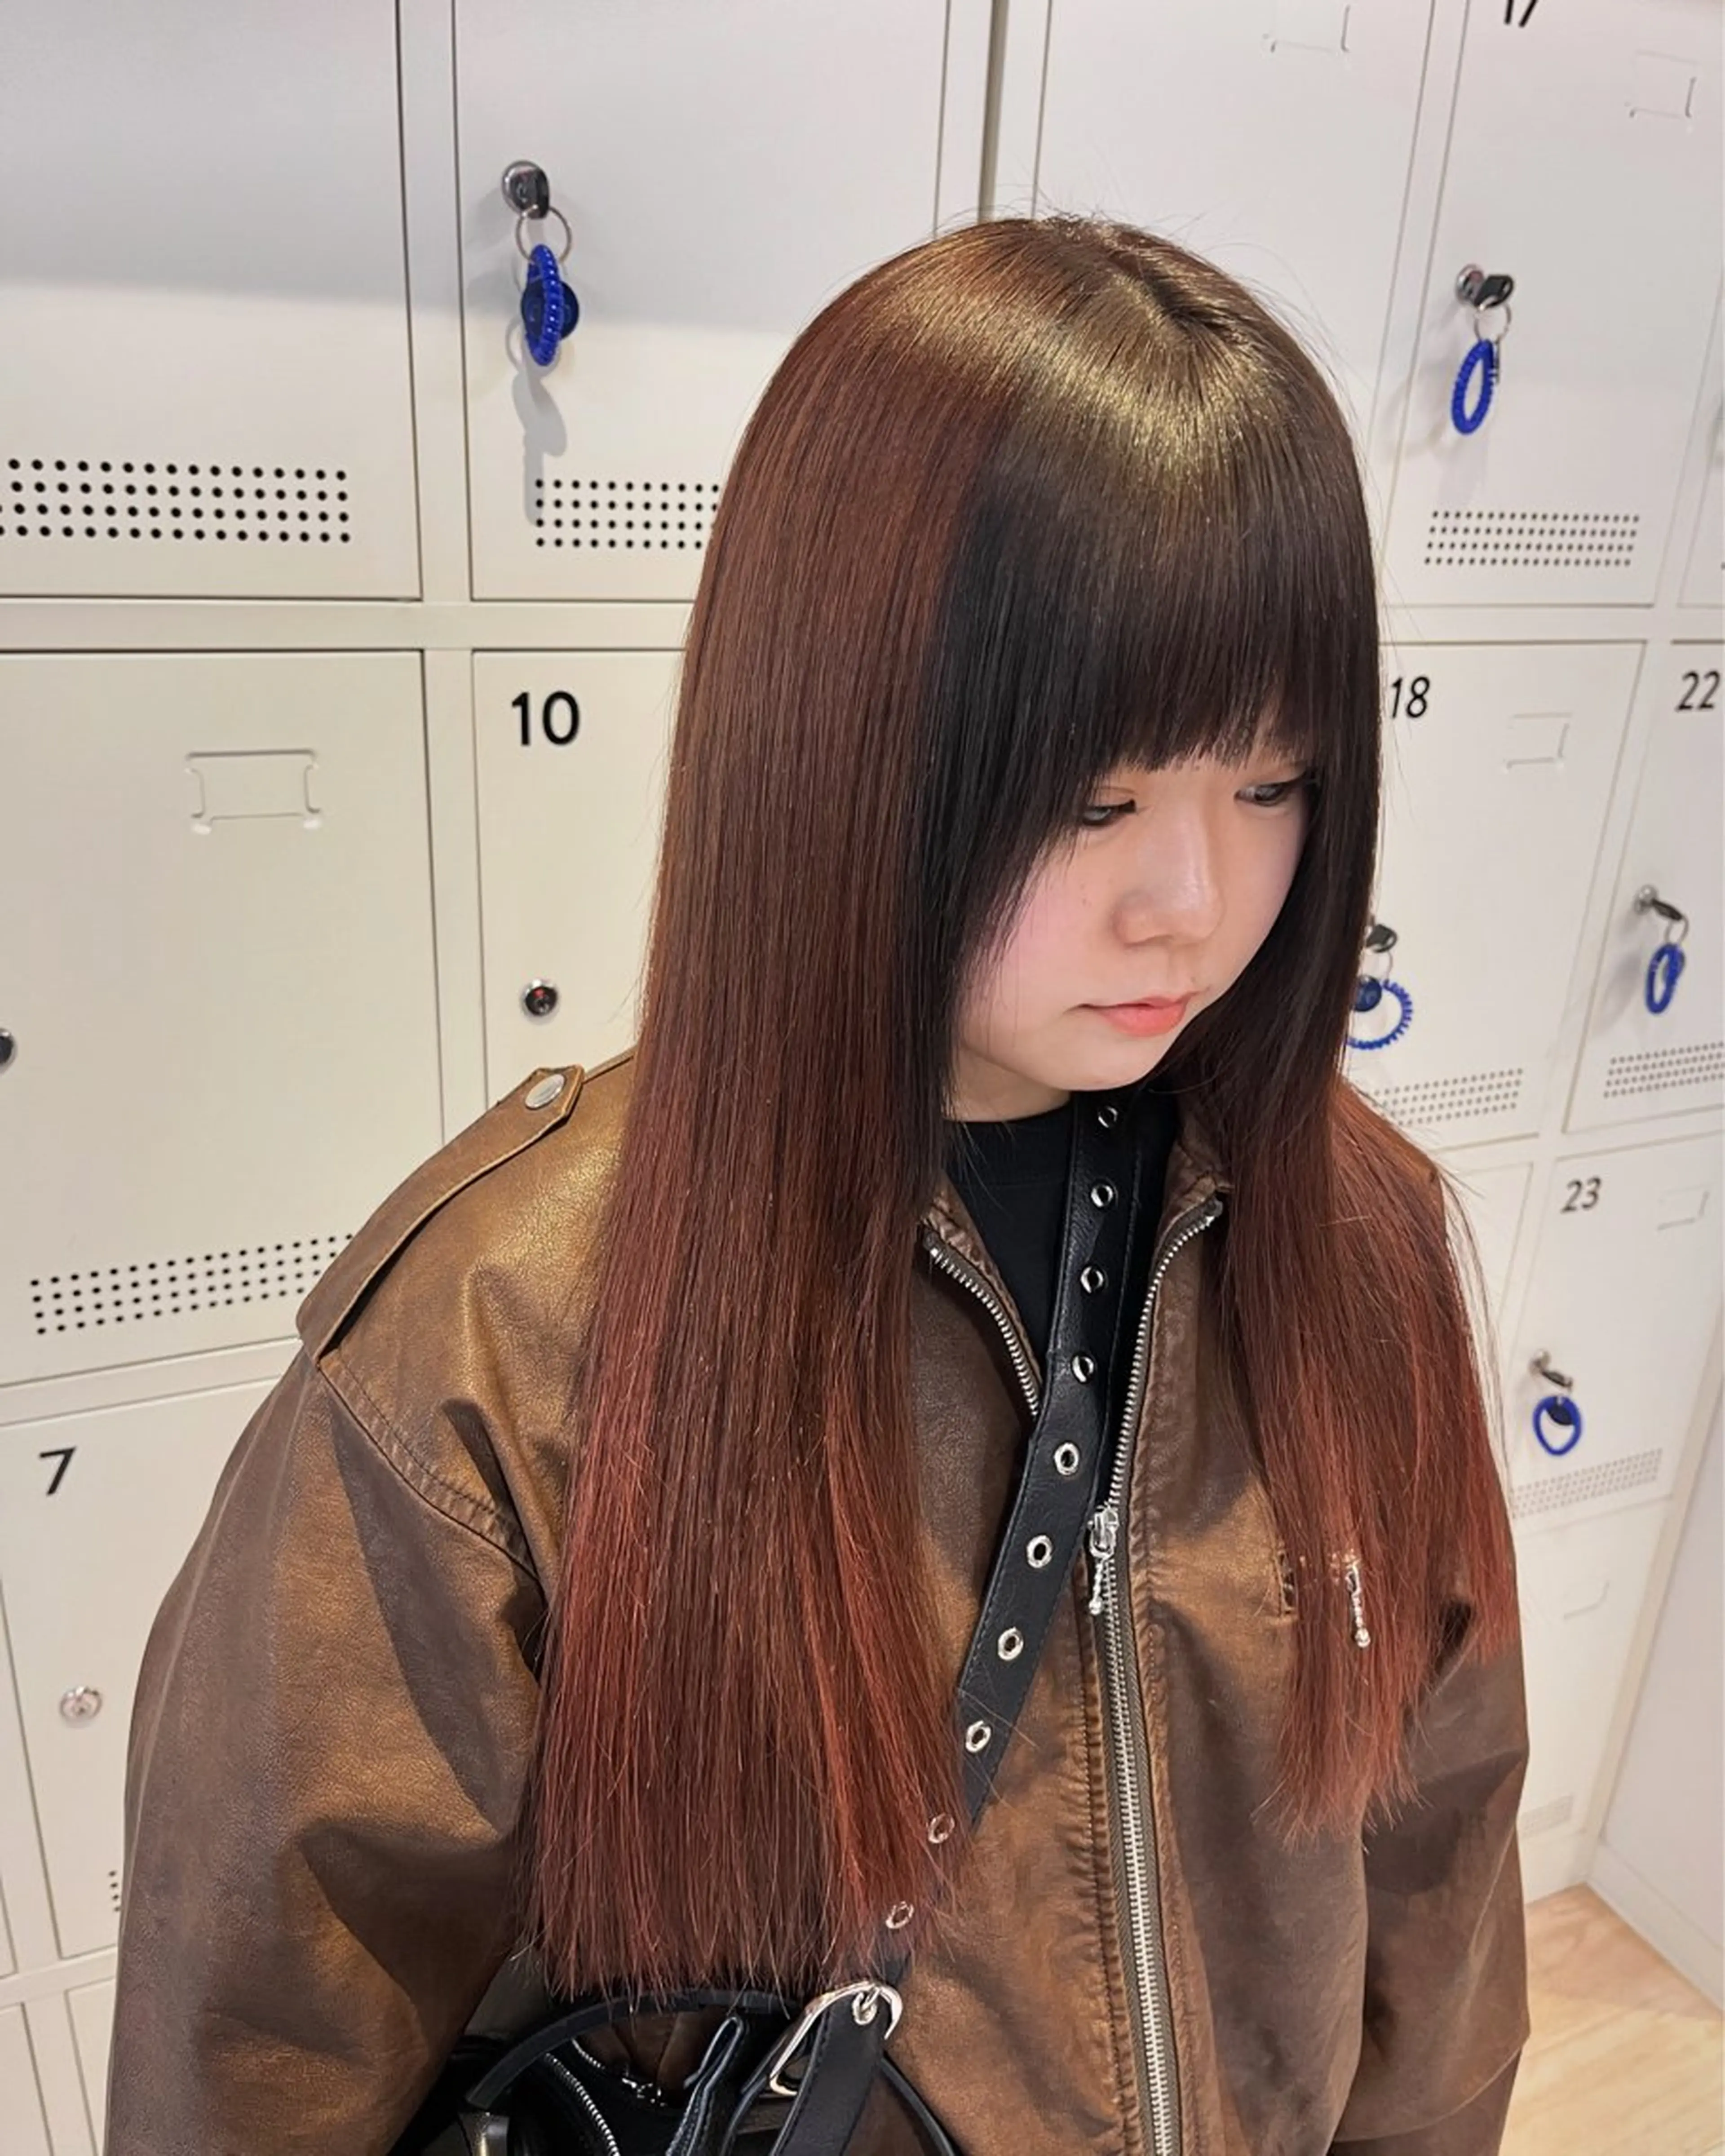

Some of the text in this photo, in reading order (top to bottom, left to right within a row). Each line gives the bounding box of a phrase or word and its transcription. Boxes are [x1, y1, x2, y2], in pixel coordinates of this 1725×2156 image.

[1391, 675, 1430, 720] 18
[1676, 670, 1721, 712] 22
[511, 690, 580, 747] 10
[1561, 1177, 1601, 1213] 23
[39, 1447, 76, 1496] 7
